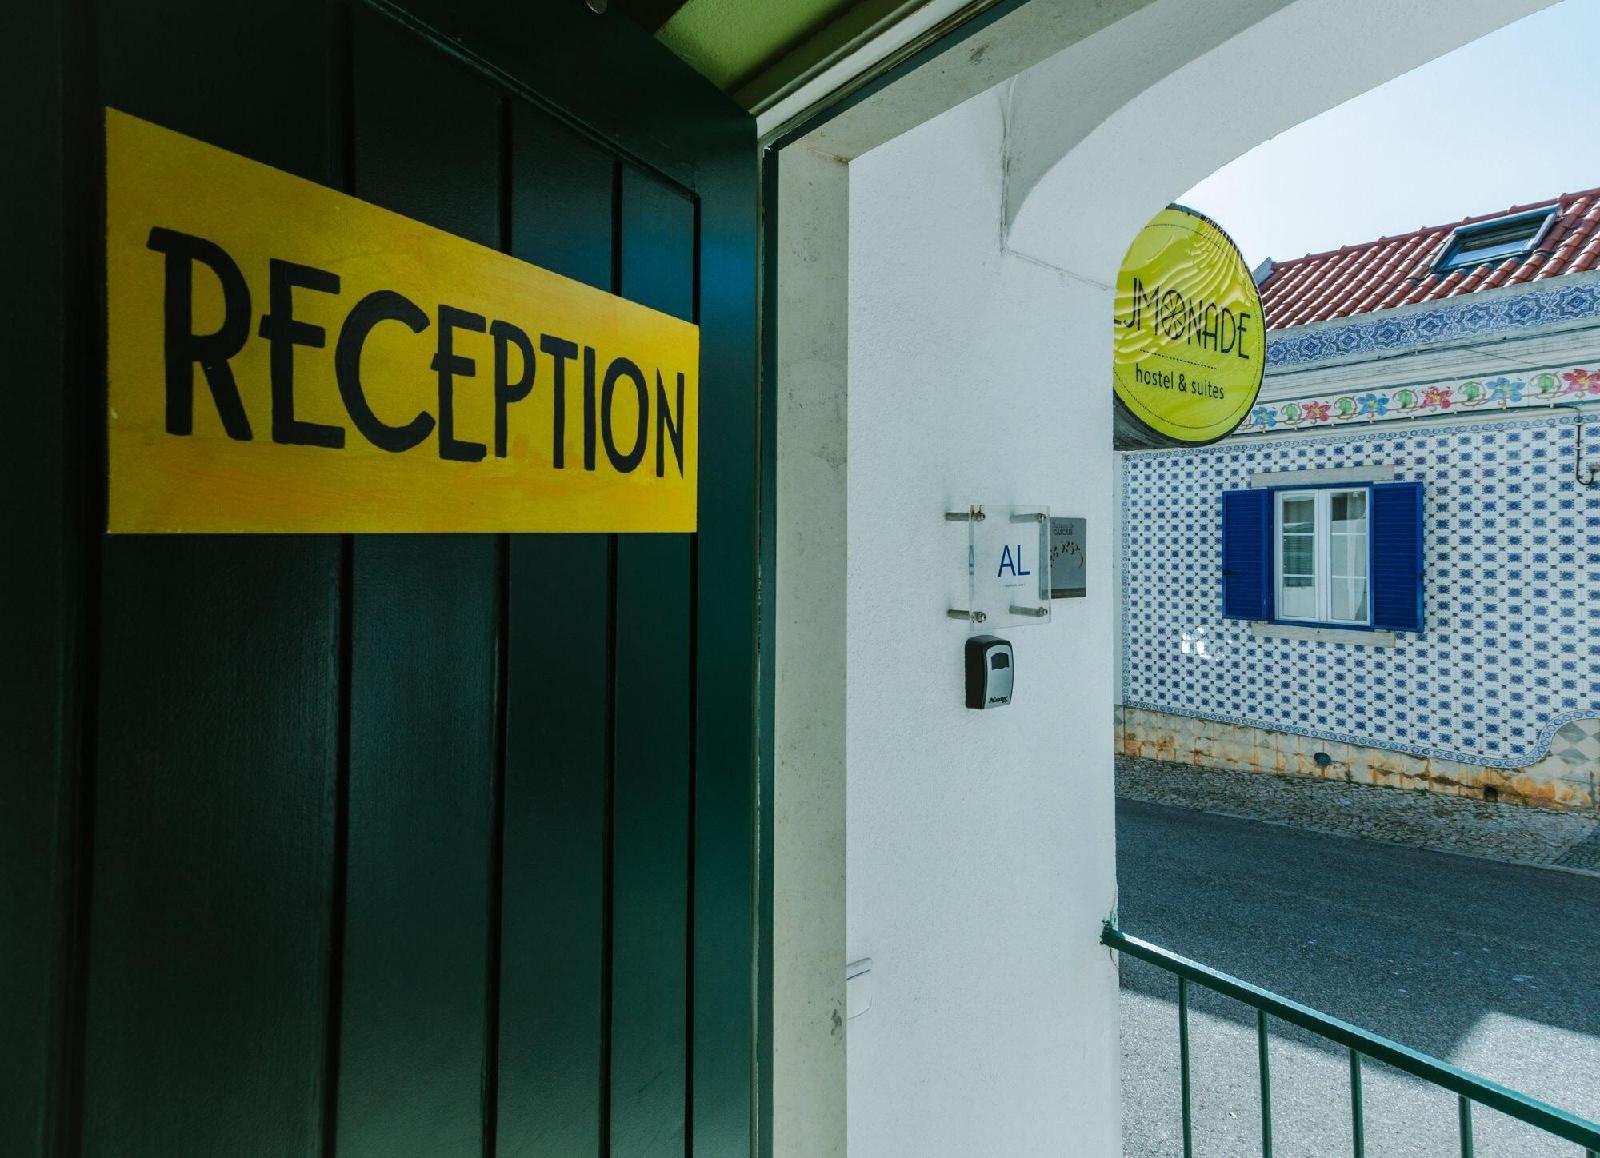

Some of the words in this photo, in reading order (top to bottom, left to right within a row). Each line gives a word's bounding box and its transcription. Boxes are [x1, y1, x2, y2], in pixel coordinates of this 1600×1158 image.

[146, 226, 685, 479] RECEPTION
[1136, 363, 1174, 390] hostel
[1178, 373, 1187, 392] &
[1191, 379, 1225, 400] suites
[997, 544, 1030, 578] AL
